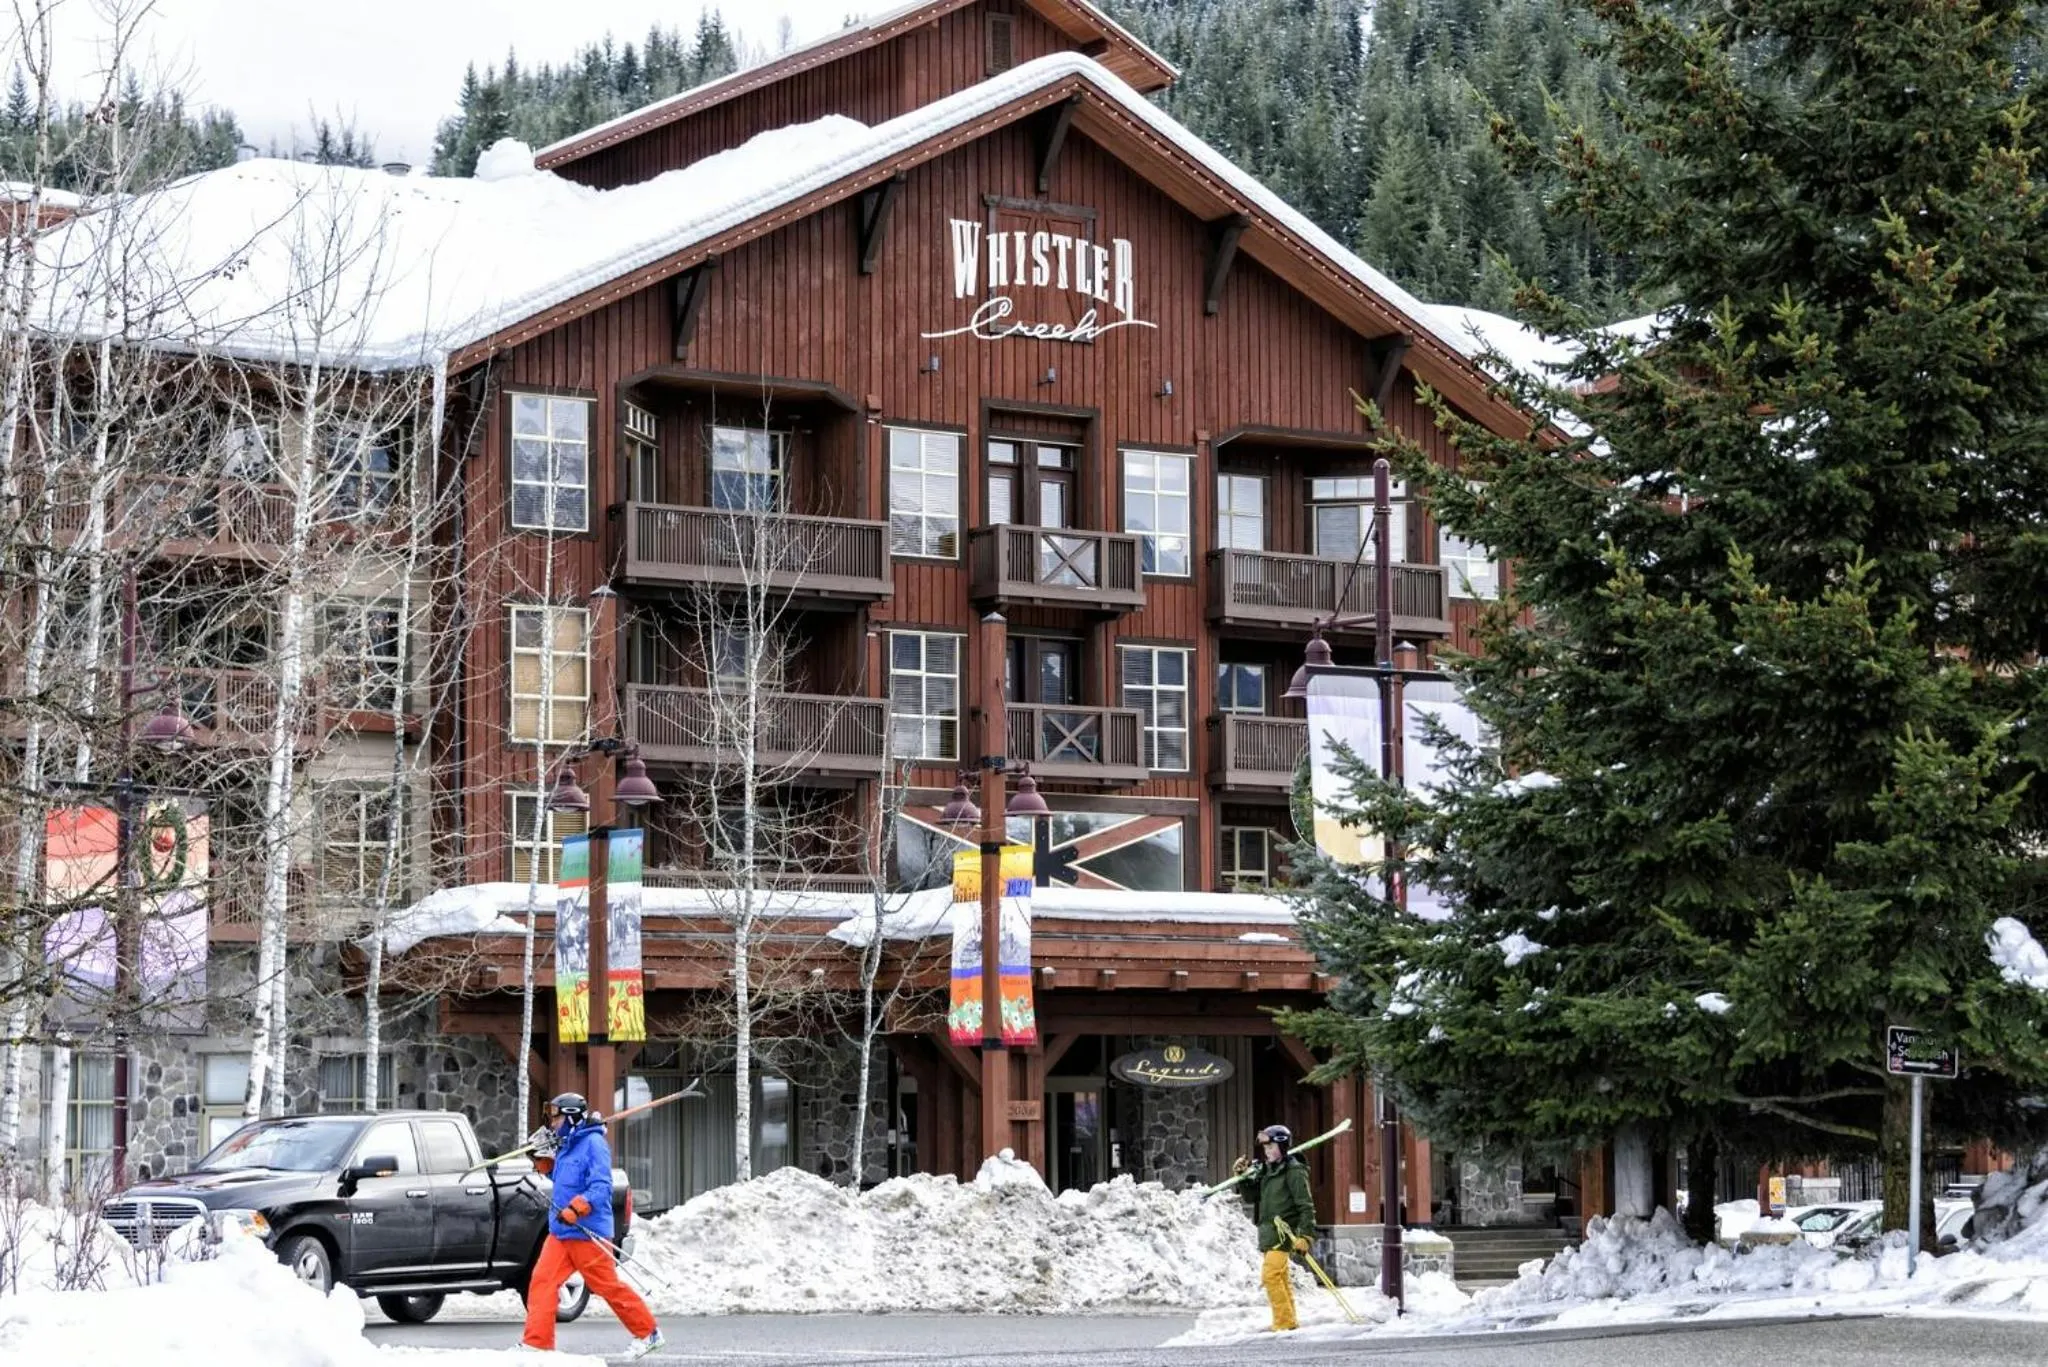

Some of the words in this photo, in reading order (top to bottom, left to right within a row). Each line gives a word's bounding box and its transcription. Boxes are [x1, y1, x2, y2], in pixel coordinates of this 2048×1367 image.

[950, 218, 1134, 321] WHISTLER
[921, 296, 1157, 340] Creek
[1126, 1059, 1221, 1083] Legends
